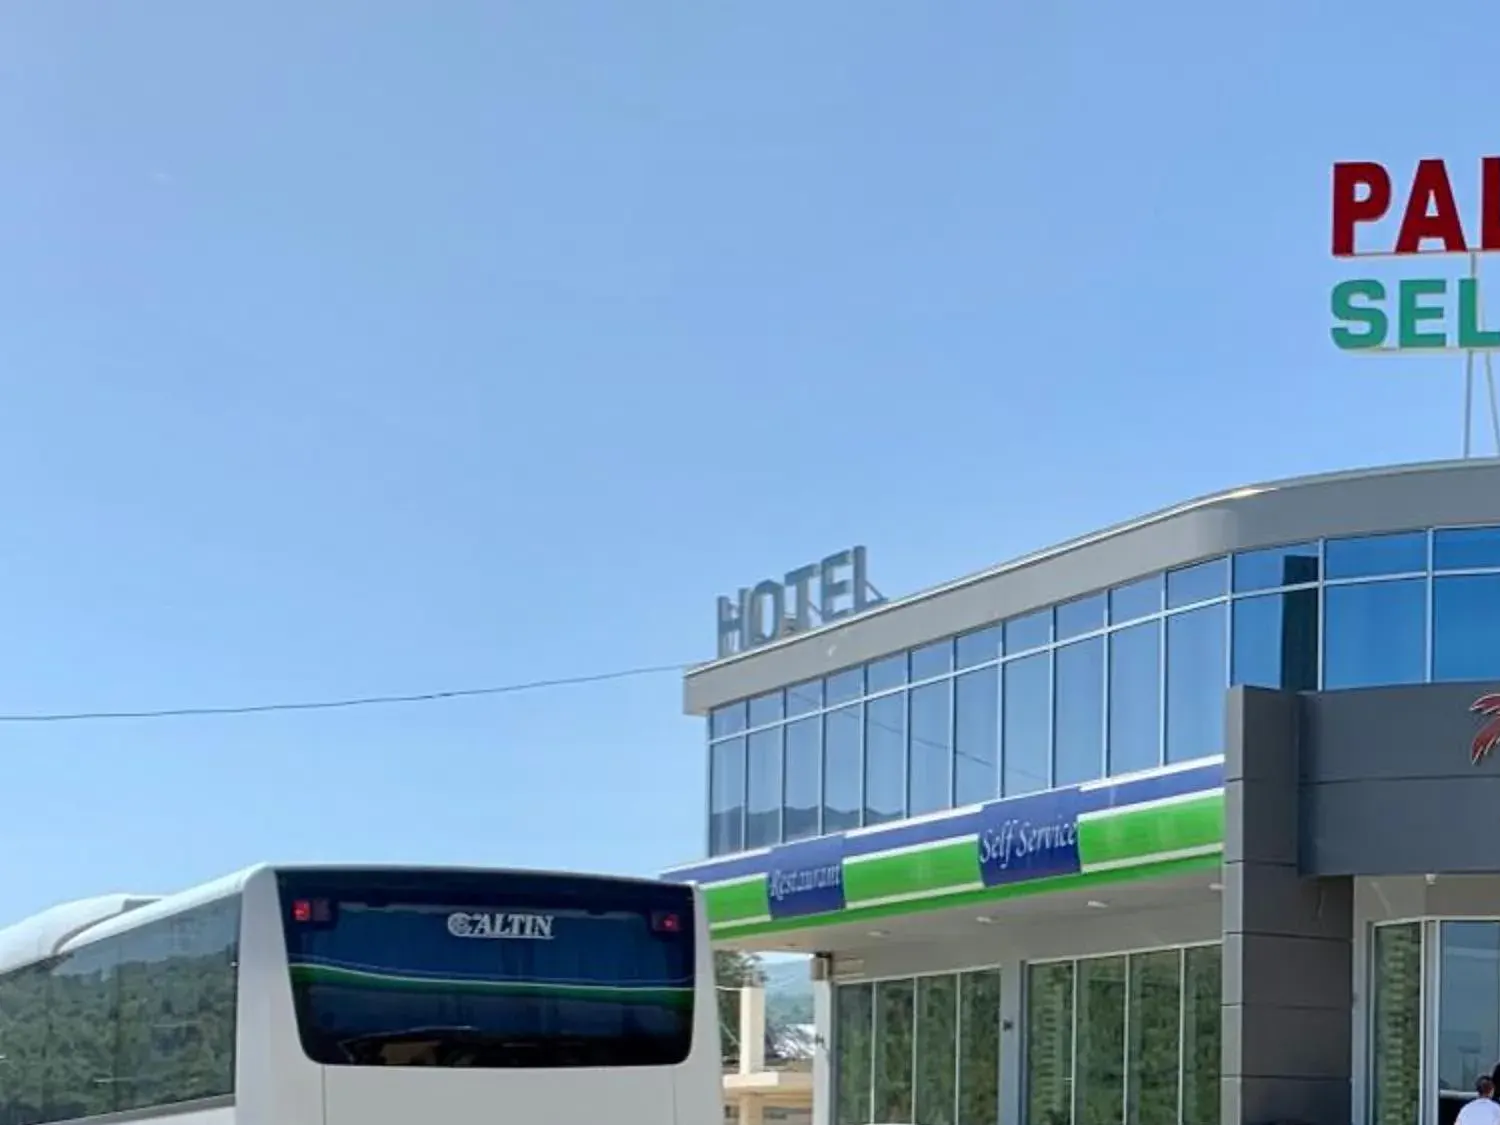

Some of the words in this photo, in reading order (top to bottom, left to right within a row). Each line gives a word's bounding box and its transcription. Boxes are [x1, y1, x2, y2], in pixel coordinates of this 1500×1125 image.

[717, 545, 887, 660] HOTEL
[979, 819, 1019, 869] Self
[1016, 814, 1076, 857] Service
[770, 864, 840, 901] Restaurant
